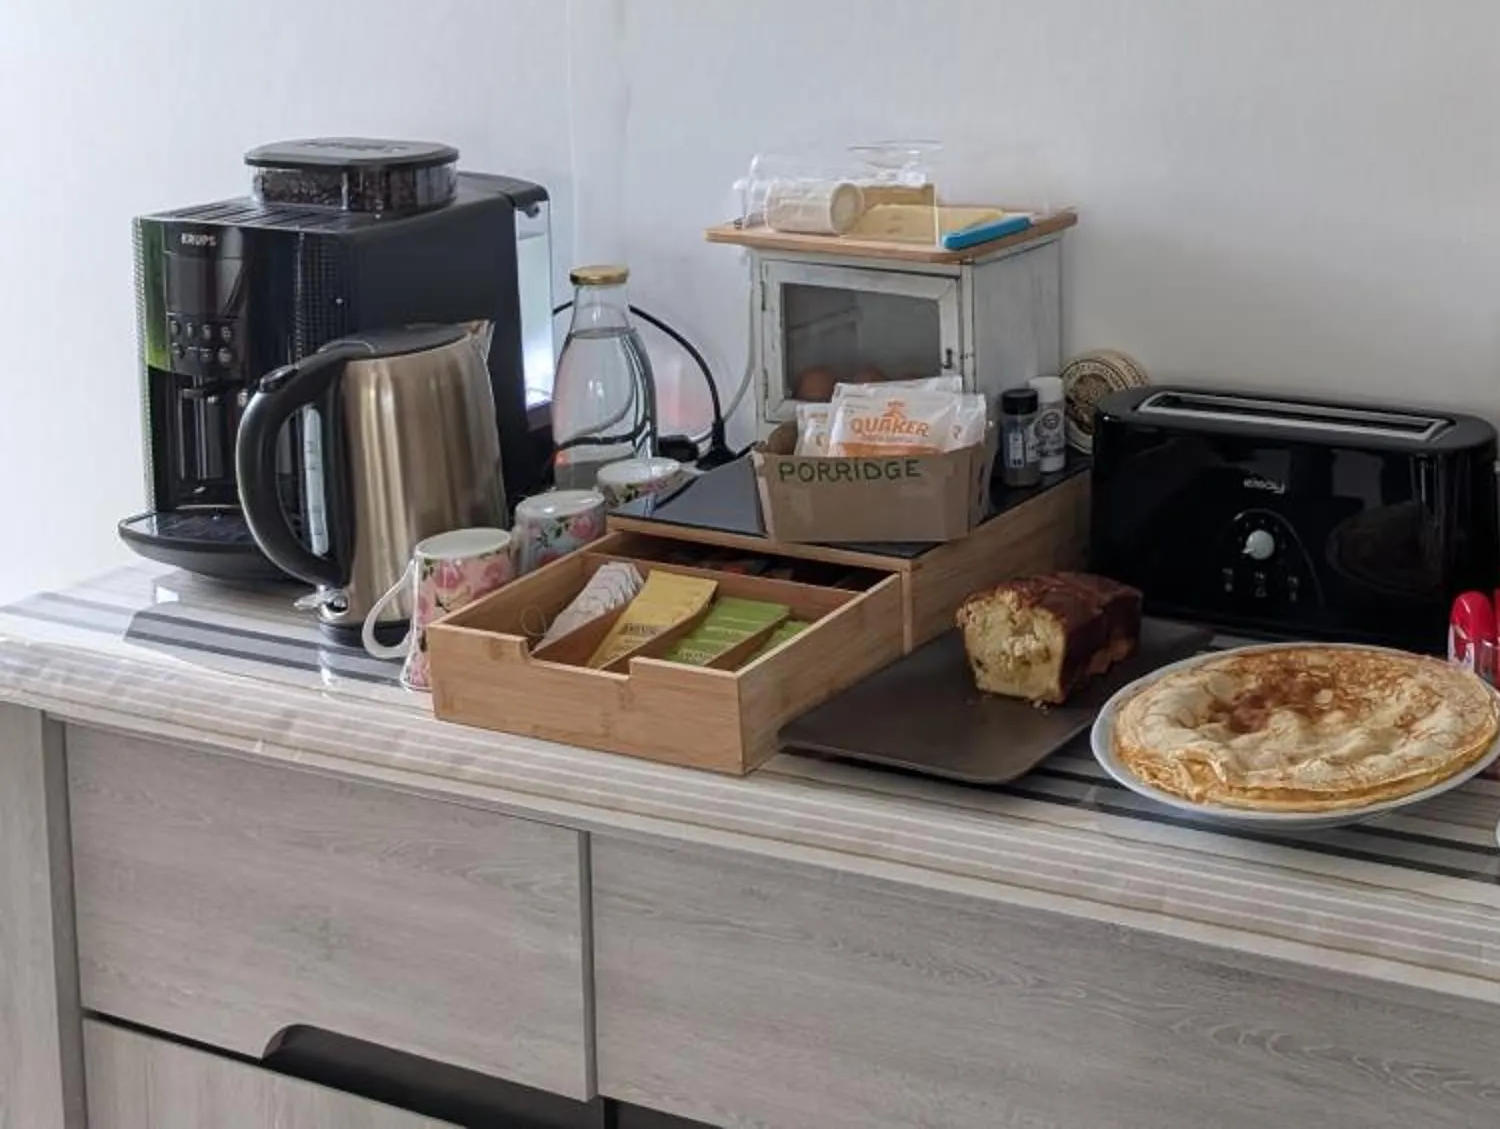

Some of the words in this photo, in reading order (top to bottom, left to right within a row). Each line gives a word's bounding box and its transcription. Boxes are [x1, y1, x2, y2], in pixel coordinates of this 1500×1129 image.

[181, 233, 217, 247] KRUPS
[850, 416, 930, 439] QUAKER
[778, 457, 922, 484] PORRIDGE
